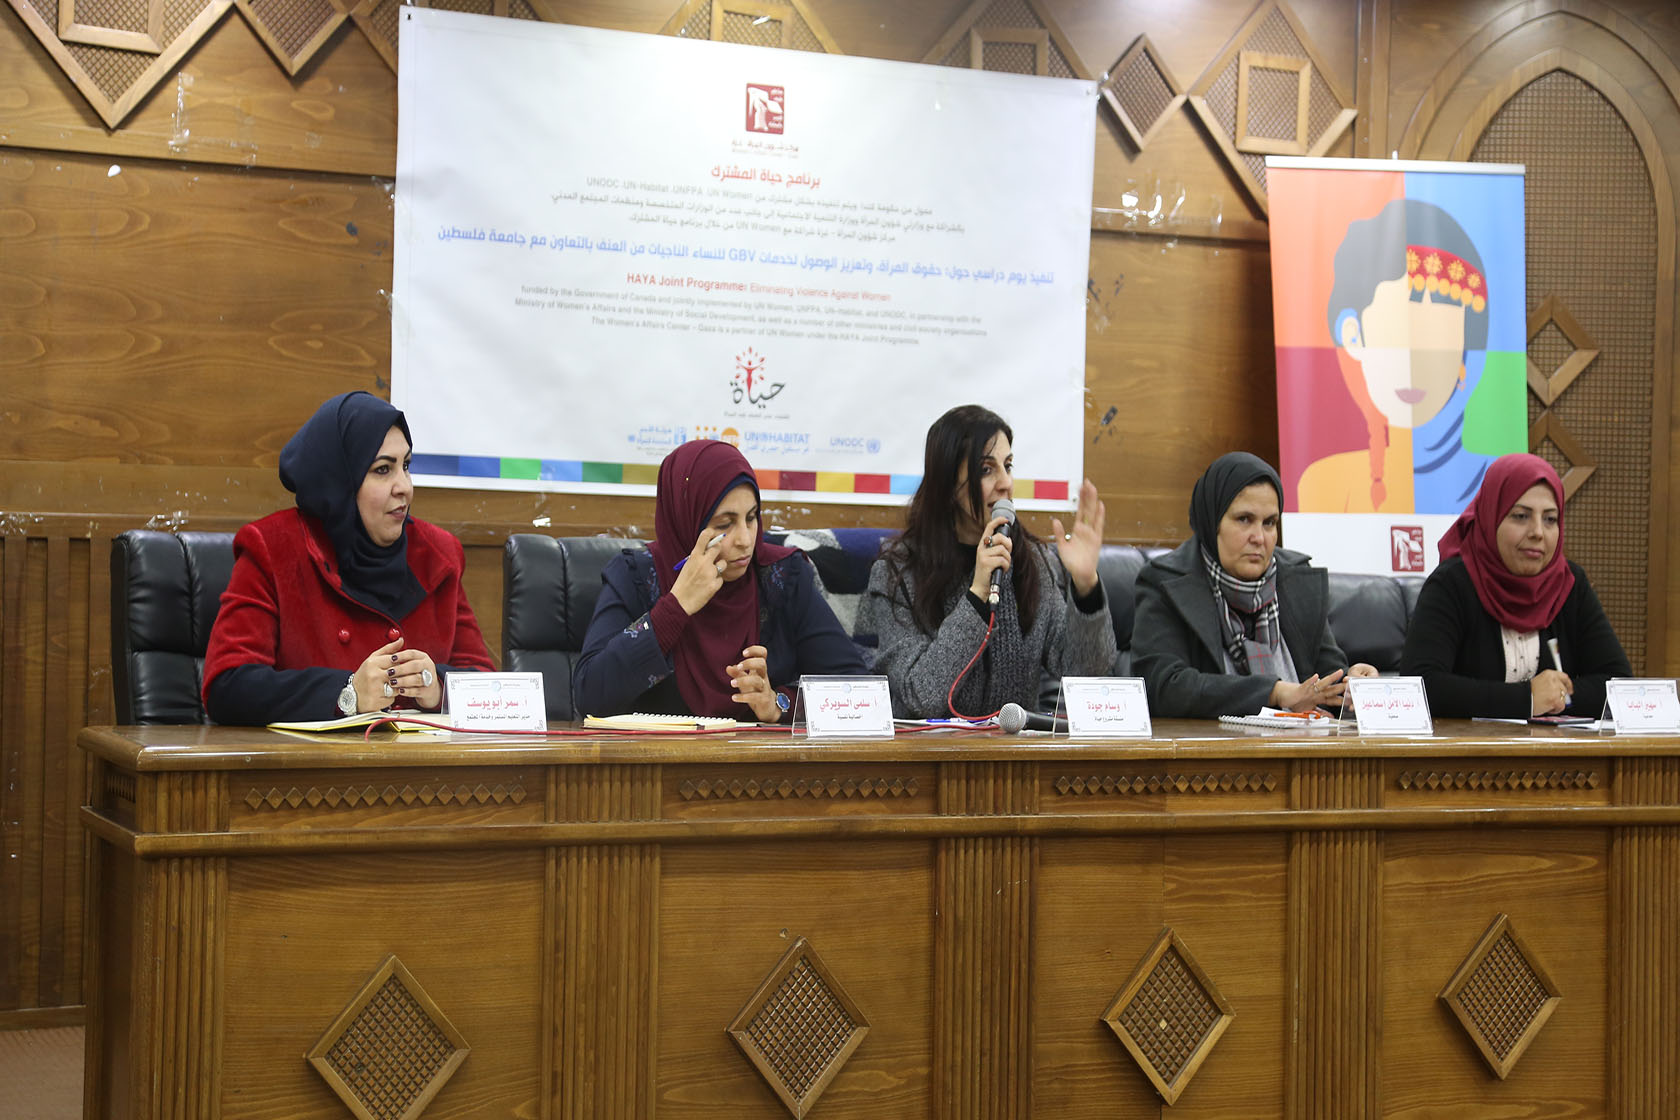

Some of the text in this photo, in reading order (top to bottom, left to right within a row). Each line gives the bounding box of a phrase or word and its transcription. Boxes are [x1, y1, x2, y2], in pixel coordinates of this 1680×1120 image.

[711, 164, 821, 191] برنامج حياة المشترك
[437, 224, 487, 242] فلسطين
[488, 228, 527, 249] جامعة
[529, 233, 548, 251] مع
[549, 234, 594, 253] بالتعاون
[596, 237, 628, 254] العنف
[629, 240, 646, 256] من
[648, 242, 689, 260] الناجيات
[693, 244, 726, 261] للنساء
[728, 247, 758, 262] GBV
[758, 250, 798, 267] لخدمات
[801, 253, 839, 272] الوصول
[627, 272, 657, 286] HAYA
[658, 275, 685, 288] Joint
[972, 267, 1005, 284] دراسي
[1007, 271, 1028, 286] يوم
[514, 297, 546, 310] Ministry
[592, 315, 606, 326] The
[467, 697, 492, 712] يوسف
[504, 699, 519, 711] سمر
[853, 698, 871, 711] سلمى
[1086, 700, 1121, 714] وسام جودة
